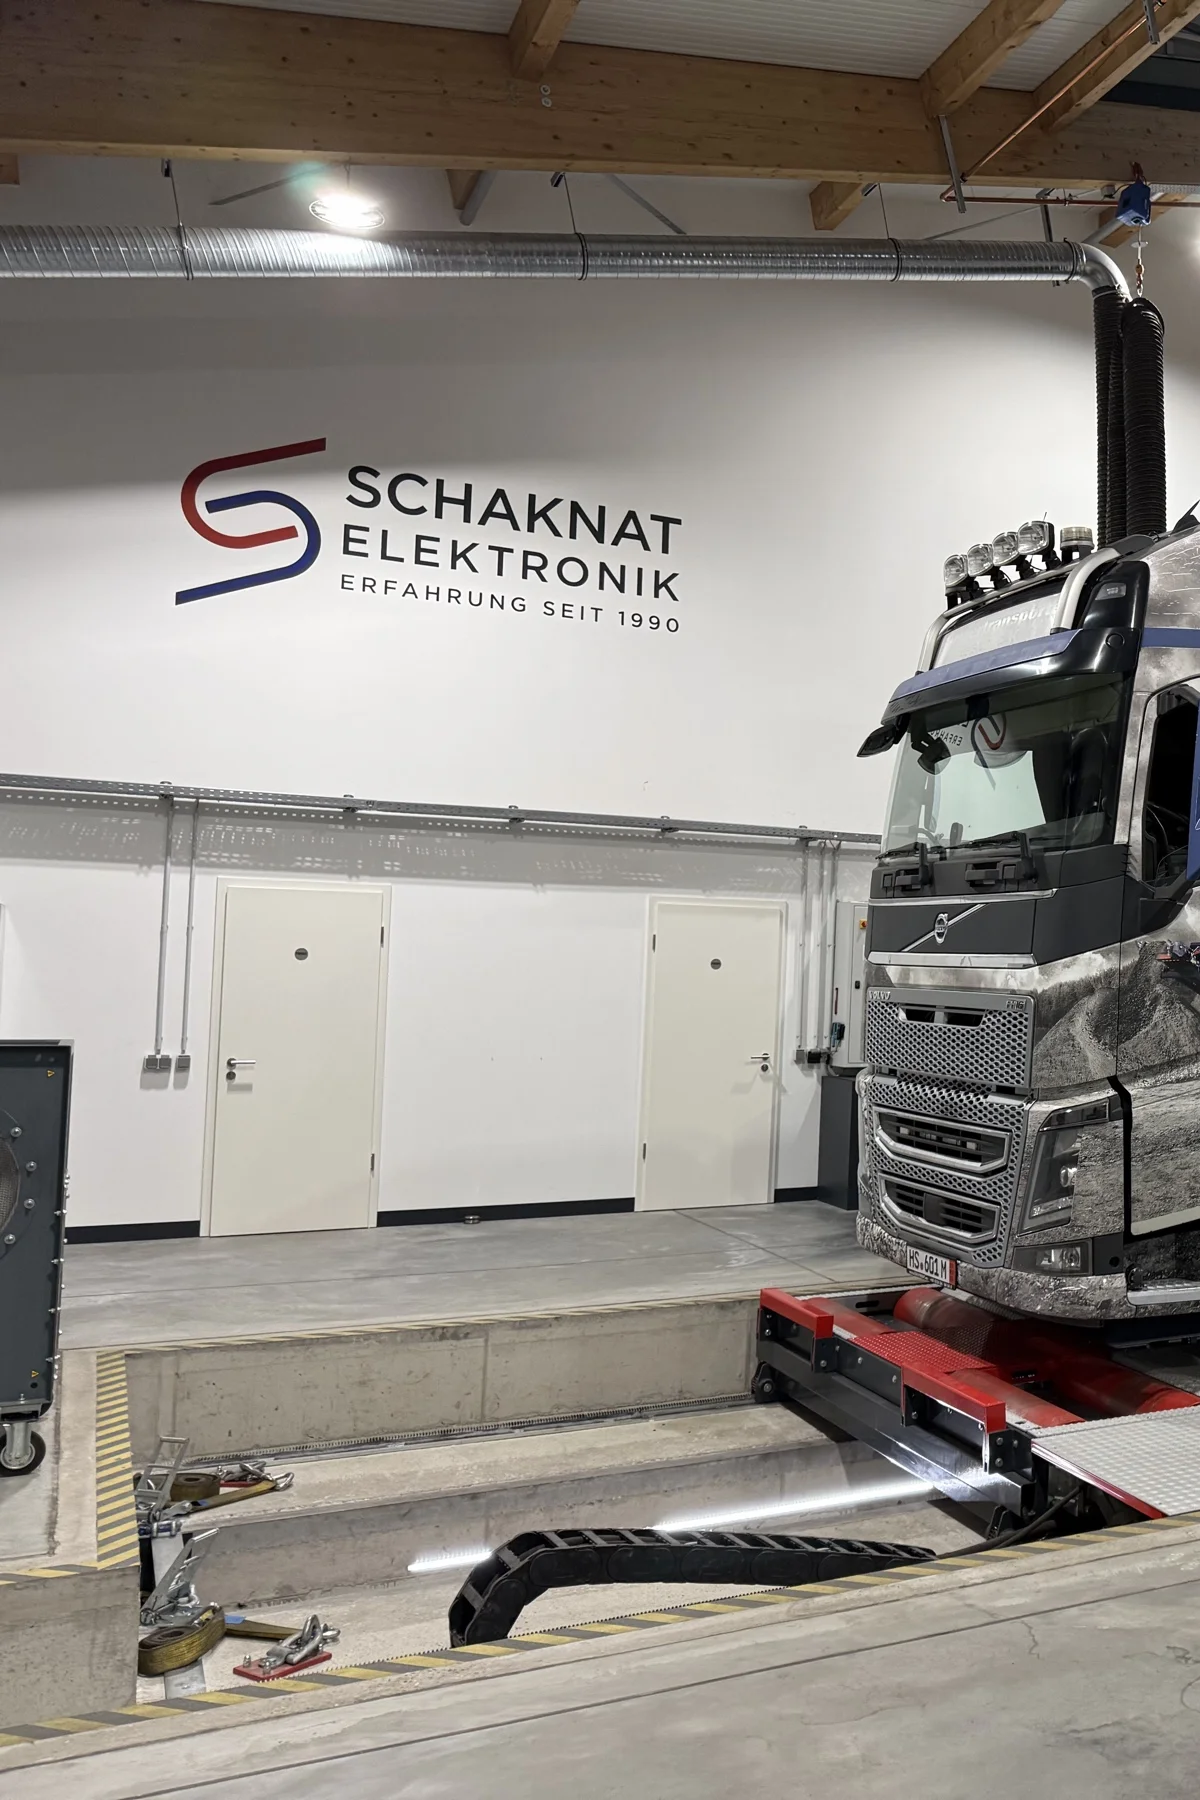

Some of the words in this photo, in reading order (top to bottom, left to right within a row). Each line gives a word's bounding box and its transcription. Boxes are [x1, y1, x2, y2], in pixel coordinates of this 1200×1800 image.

[345, 465, 683, 554] SCHAKNAT
[342, 523, 680, 602] ELEKTRONIK
[340, 574, 527, 613] ERFAHRUNG
[542, 600, 604, 623] SEIT
[618, 611, 680, 633] 1990
[909, 1249, 919, 1269] HS
